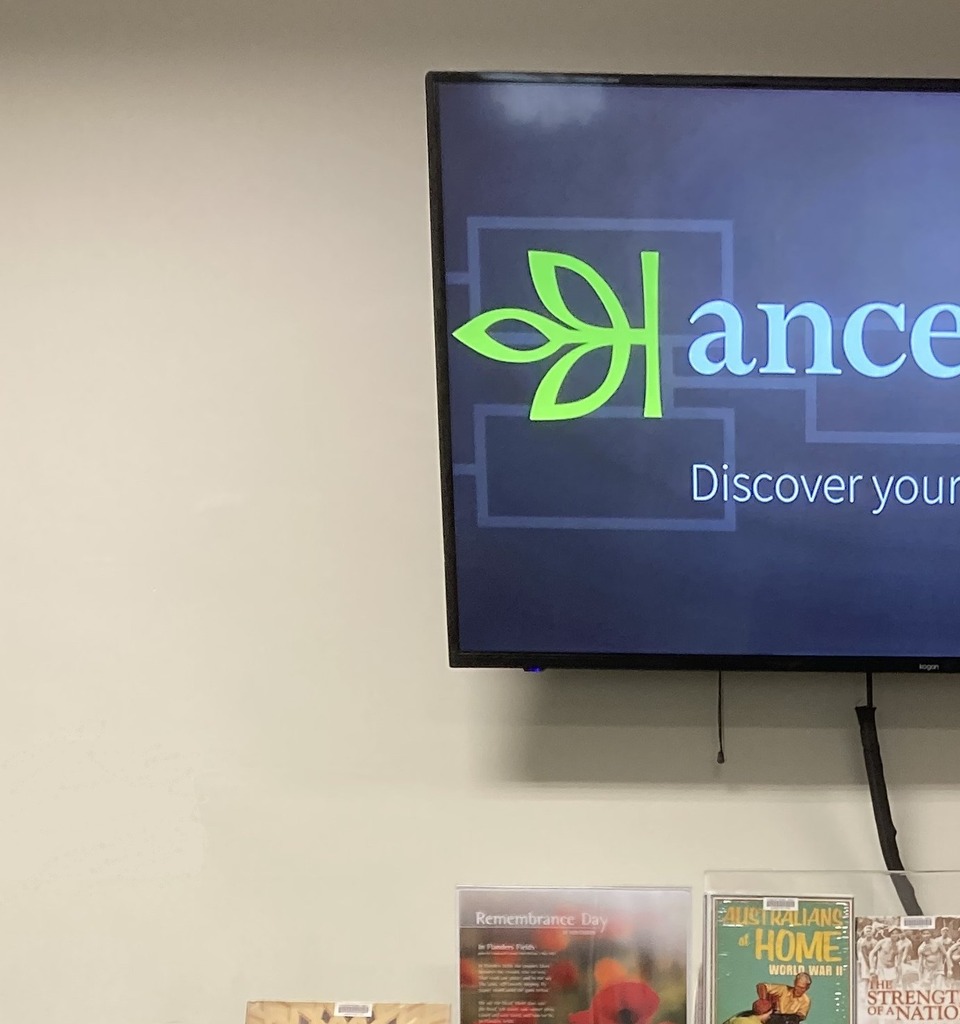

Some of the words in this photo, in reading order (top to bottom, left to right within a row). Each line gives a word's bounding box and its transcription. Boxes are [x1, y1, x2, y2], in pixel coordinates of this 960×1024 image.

[691, 464, 863, 505] Discover
[475, 911, 575, 926] Remembrance
[581, 912, 608, 932] Day
[722, 906, 844, 927] AUSTRALIANS
[738, 933, 750, 946] at
[755, 928, 842, 963] HOME
[768, 964, 806, 976] WORLD
[808, 965, 832, 976] WAR
[836, 965, 843, 976] II
[869, 980, 892, 990] THE
[867, 1006, 884, 1016] OF
[886, 1006, 894, 1016] A
